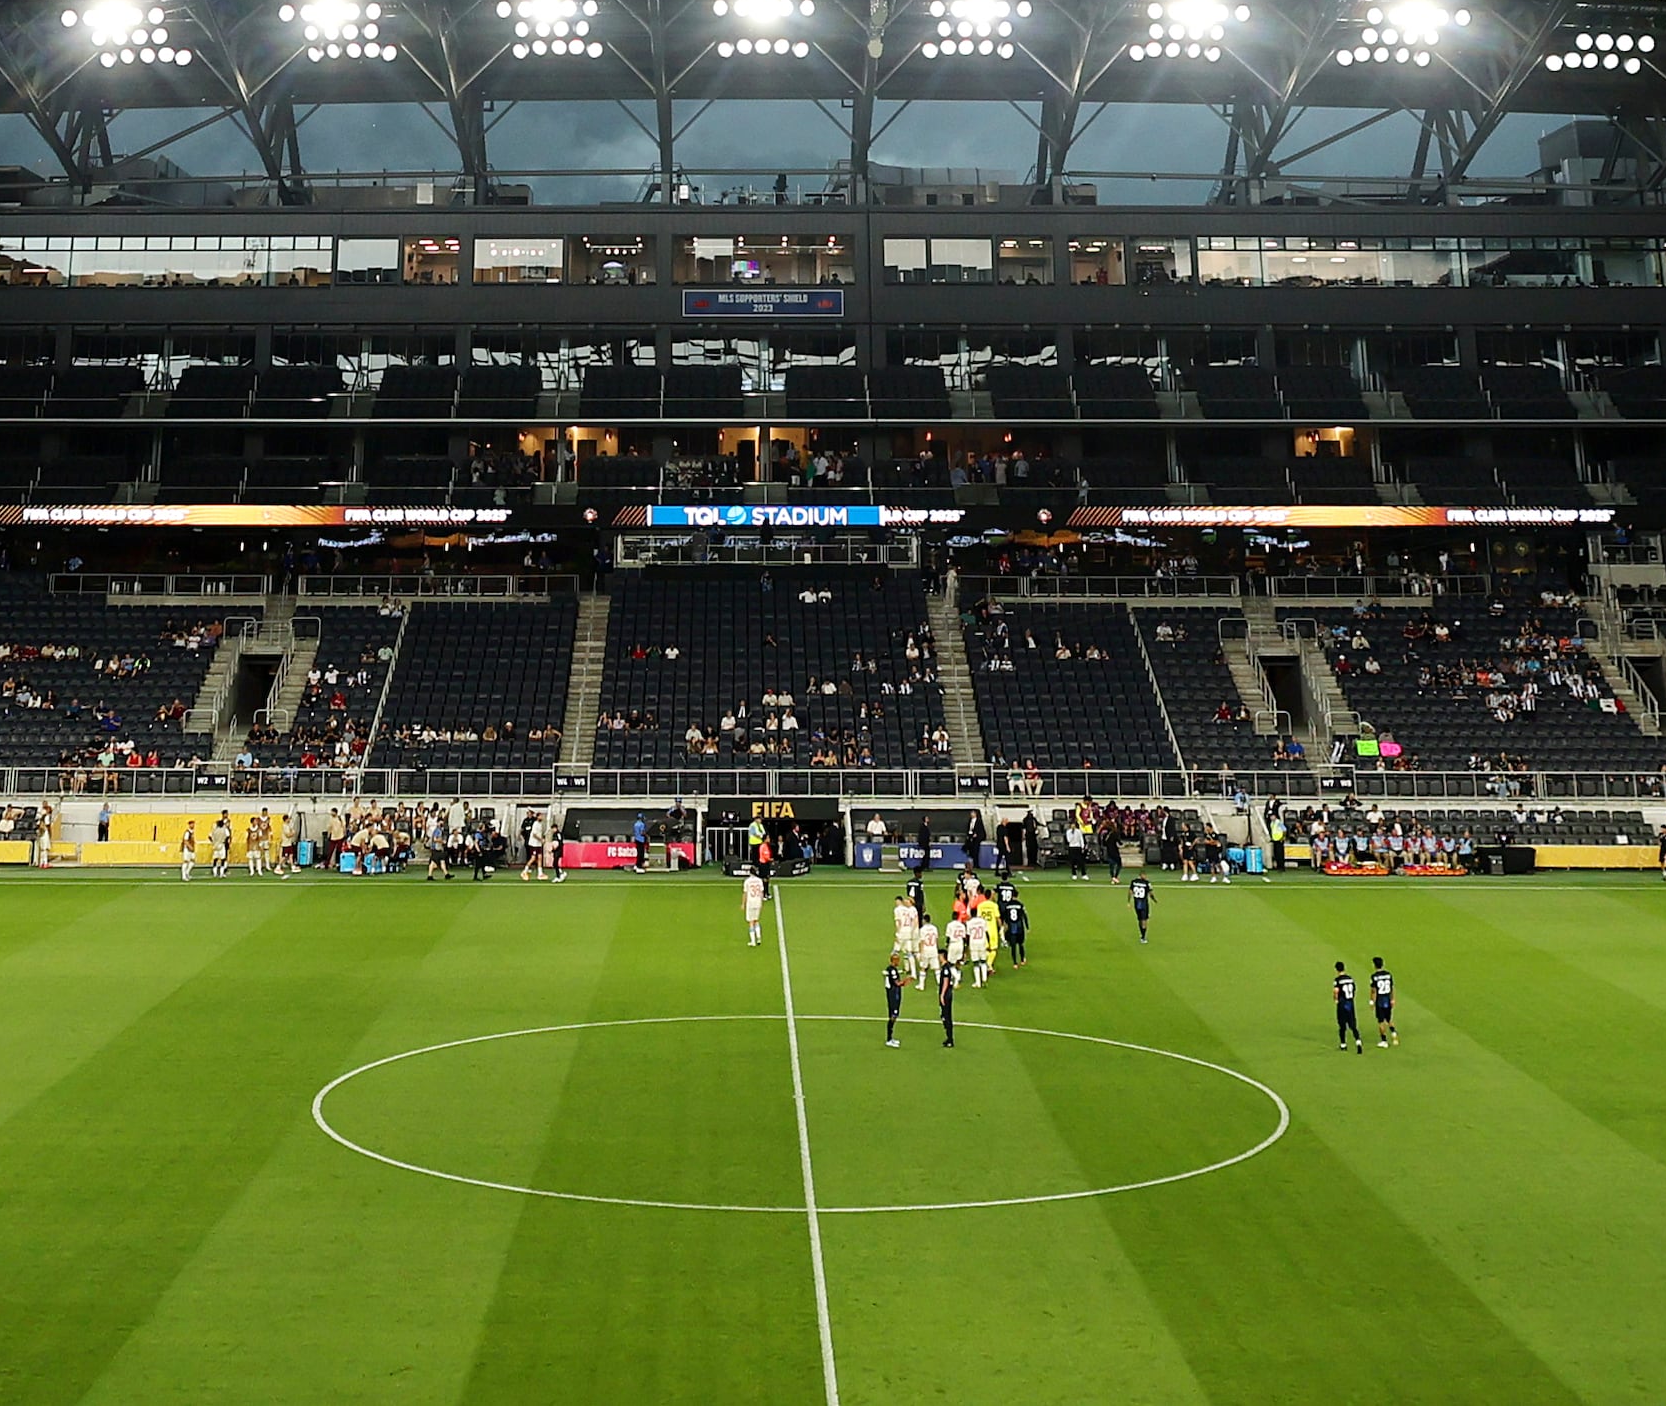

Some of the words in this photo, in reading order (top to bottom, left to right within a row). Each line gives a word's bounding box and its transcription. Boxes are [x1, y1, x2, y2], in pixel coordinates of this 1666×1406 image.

[718, 293, 733, 303] MLS
[735, 293, 782, 303] SUPPORTERS'
[784, 293, 808, 303] SHIELD
[753, 304, 774, 313] 2023
[23, 509, 49, 521] FIFA
[51, 509, 81, 521] CLUB
[83, 509, 127, 521] WORLD
[128, 509, 153, 521] CUP
[345, 509, 371, 521] FIFA
[373, 509, 403, 521] CLUB
[405, 509, 449, 521] WORLD
[451, 509, 475, 521] CUP
[684, 507, 727, 525] TQL
[752, 508, 847, 525] STADIUM
[904, 510, 928, 522] CUP
[1123, 510, 1149, 522] FIFA
[1151, 510, 1181, 522] CLUB
[1183, 510, 1227, 522] WORLD
[1229, 510, 1253, 522] CUP
[1448, 510, 1474, 522] FIFA
[1475, 510, 1507, 522] CLUB
[1508, 510, 1552, 522] WORLD
[1553, 510, 1578, 522] CUP
[751, 801, 795, 819] FIFA
[607, 847, 617, 857] FC
[900, 849, 909, 859] CF
[908, 886, 915, 898] 4
[1010, 909, 1018, 921] 8
